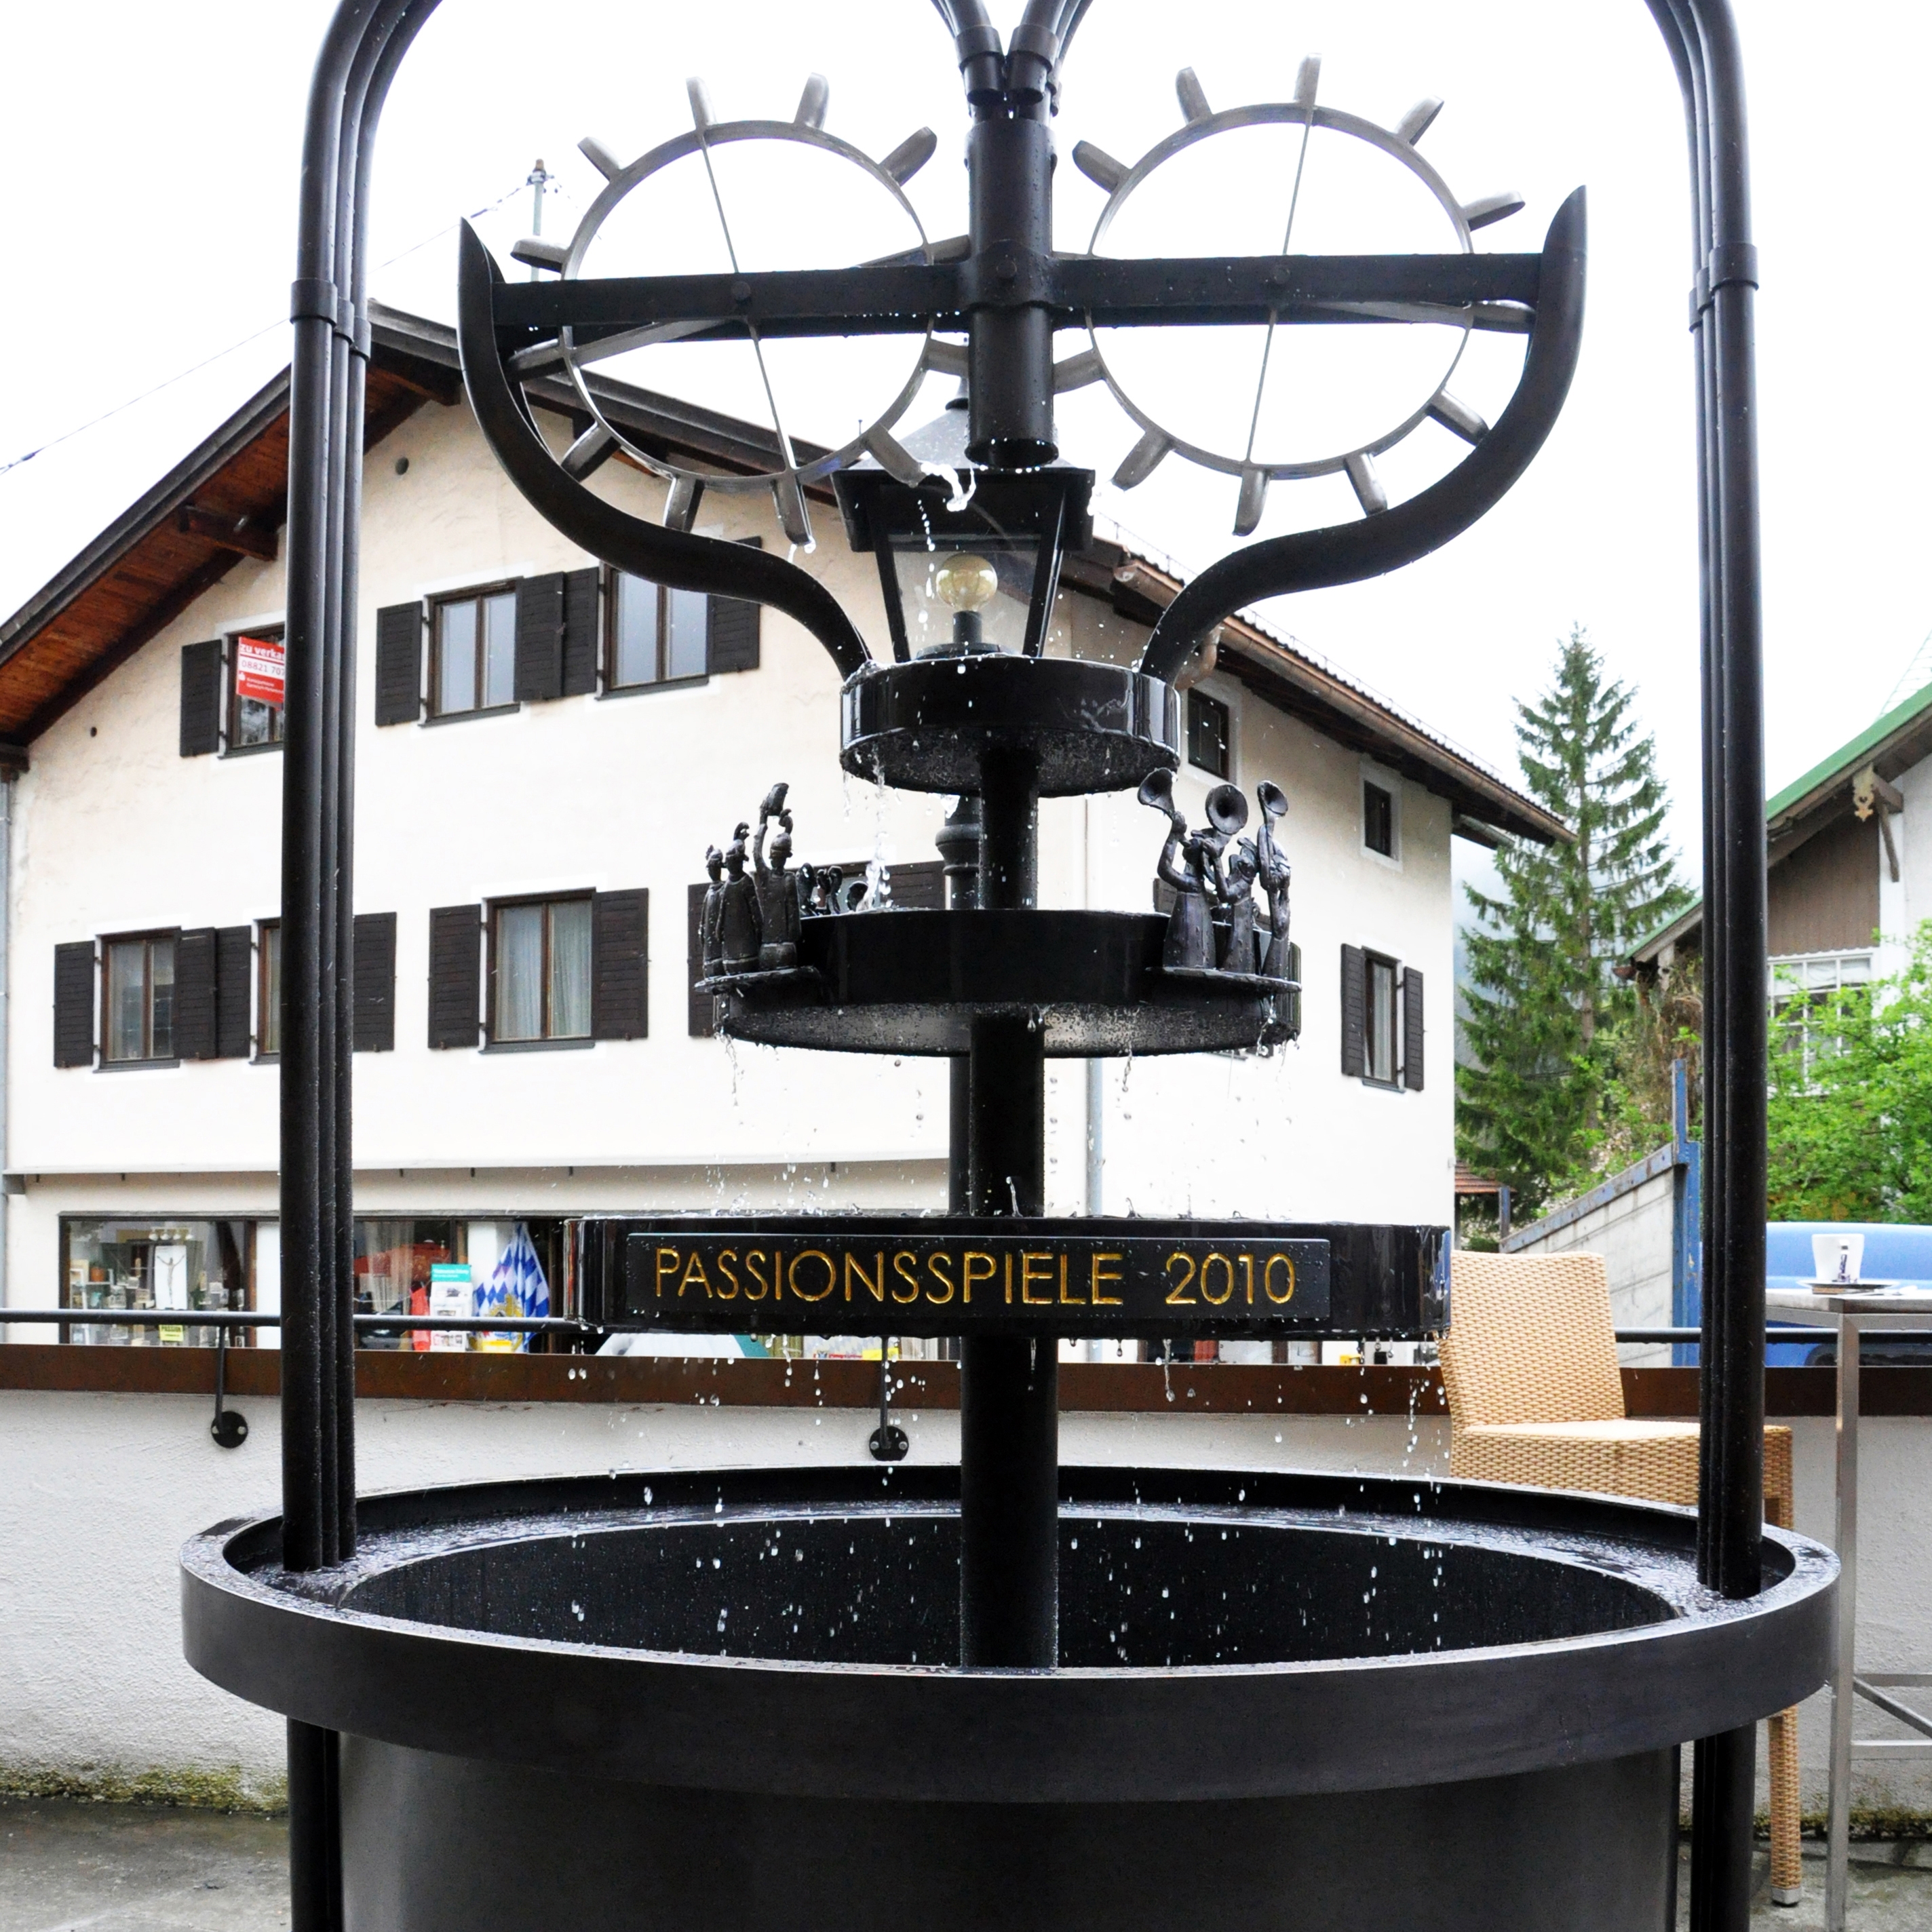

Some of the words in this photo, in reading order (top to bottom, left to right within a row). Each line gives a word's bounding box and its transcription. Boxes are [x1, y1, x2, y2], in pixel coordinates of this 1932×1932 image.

[239, 644, 252, 653] zu
[242, 660, 267, 672] 08821
[655, 1248, 1123, 1305] PASSIONSSPIELE
[1165, 1252, 1296, 1305] 2010
